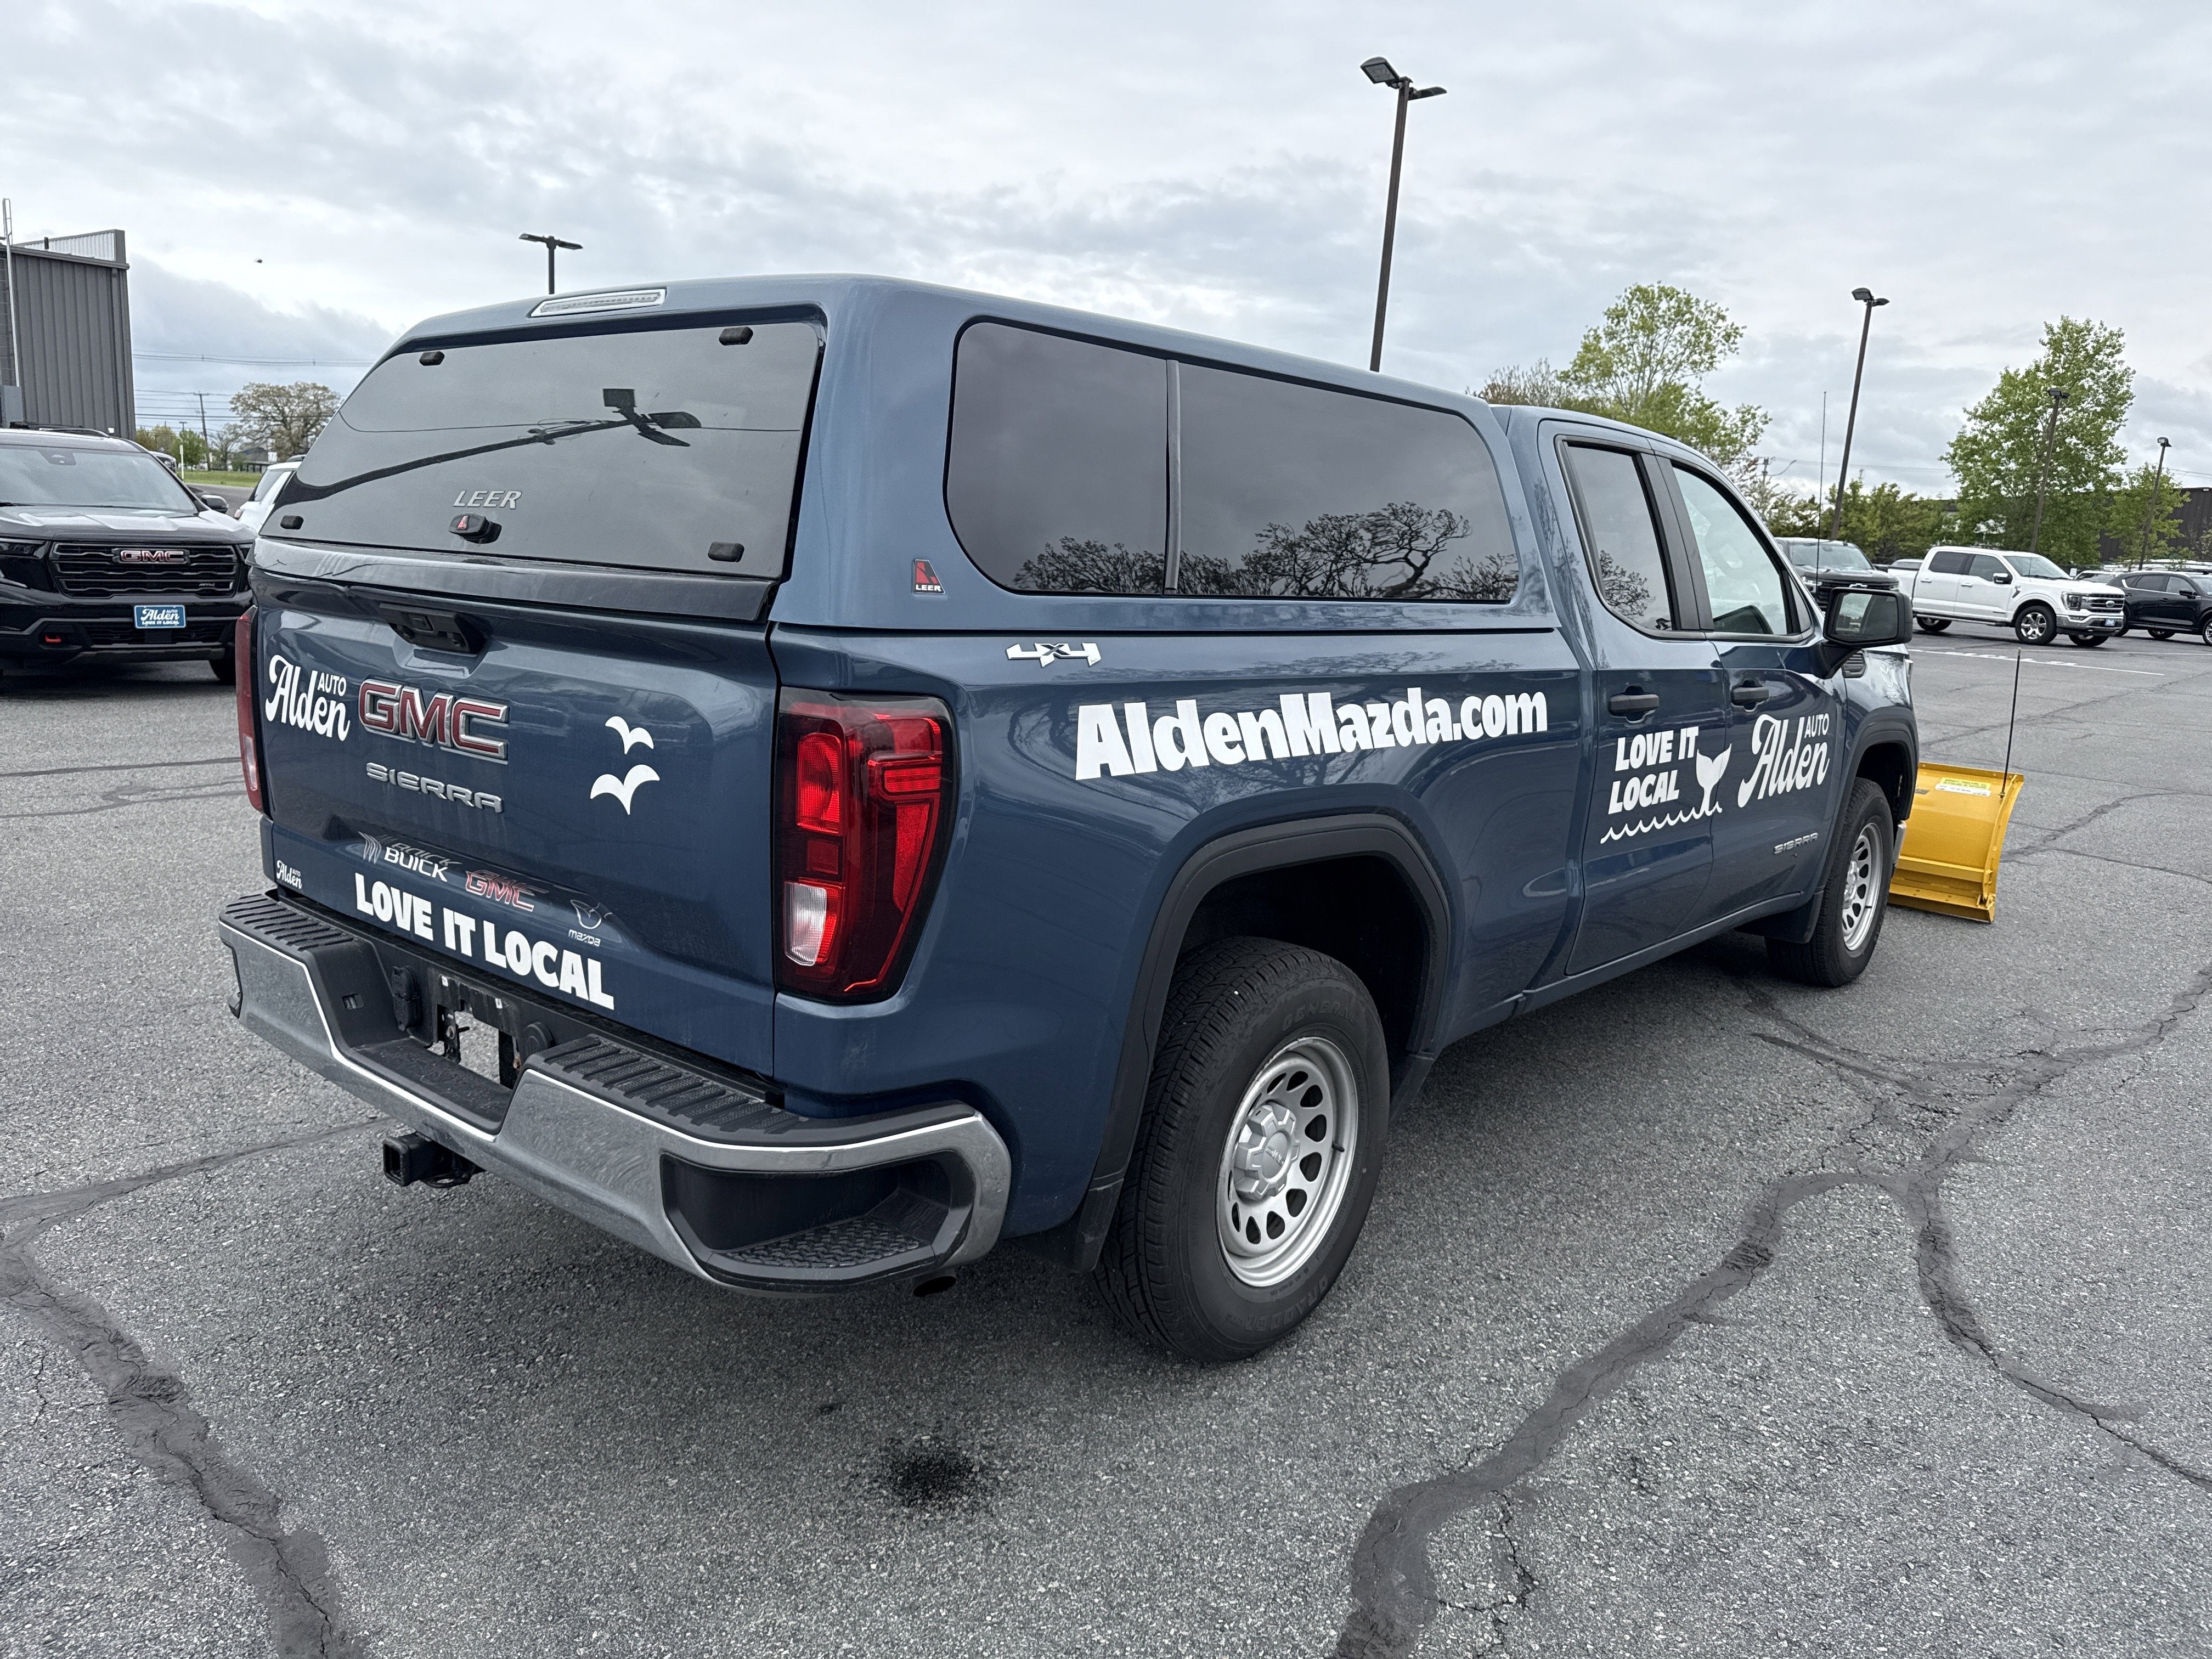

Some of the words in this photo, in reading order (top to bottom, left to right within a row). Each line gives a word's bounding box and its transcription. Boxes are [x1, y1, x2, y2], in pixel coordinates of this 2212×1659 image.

[453, 490, 522, 509] LEER
[121, 550, 185, 562] GMC
[140, 609, 180, 620] Alden
[266, 655, 351, 741] Alden
[317, 673, 347, 696] AUTO
[358, 678, 509, 760] GMC
[1076, 687, 1548, 781] AldenMazda.com
[1804, 713, 1829, 738] AUTO
[1615, 729, 1674, 771] LOVE
[1678, 726, 1699, 760] IT
[1737, 714, 1830, 808] Alden
[366, 762, 504, 813] SIERRA
[1608, 770, 1680, 815] LOCAL
[1773, 832, 1819, 854] SIERRA
[276, 860, 303, 889] Alden
[384, 846, 449, 882] BUICK
[465, 871, 535, 912] GMC
[354, 873, 434, 941] LOVE
[443, 907, 476, 957] IT
[483, 919, 614, 1010] LOCAL
[568, 929, 601, 947] mazda
